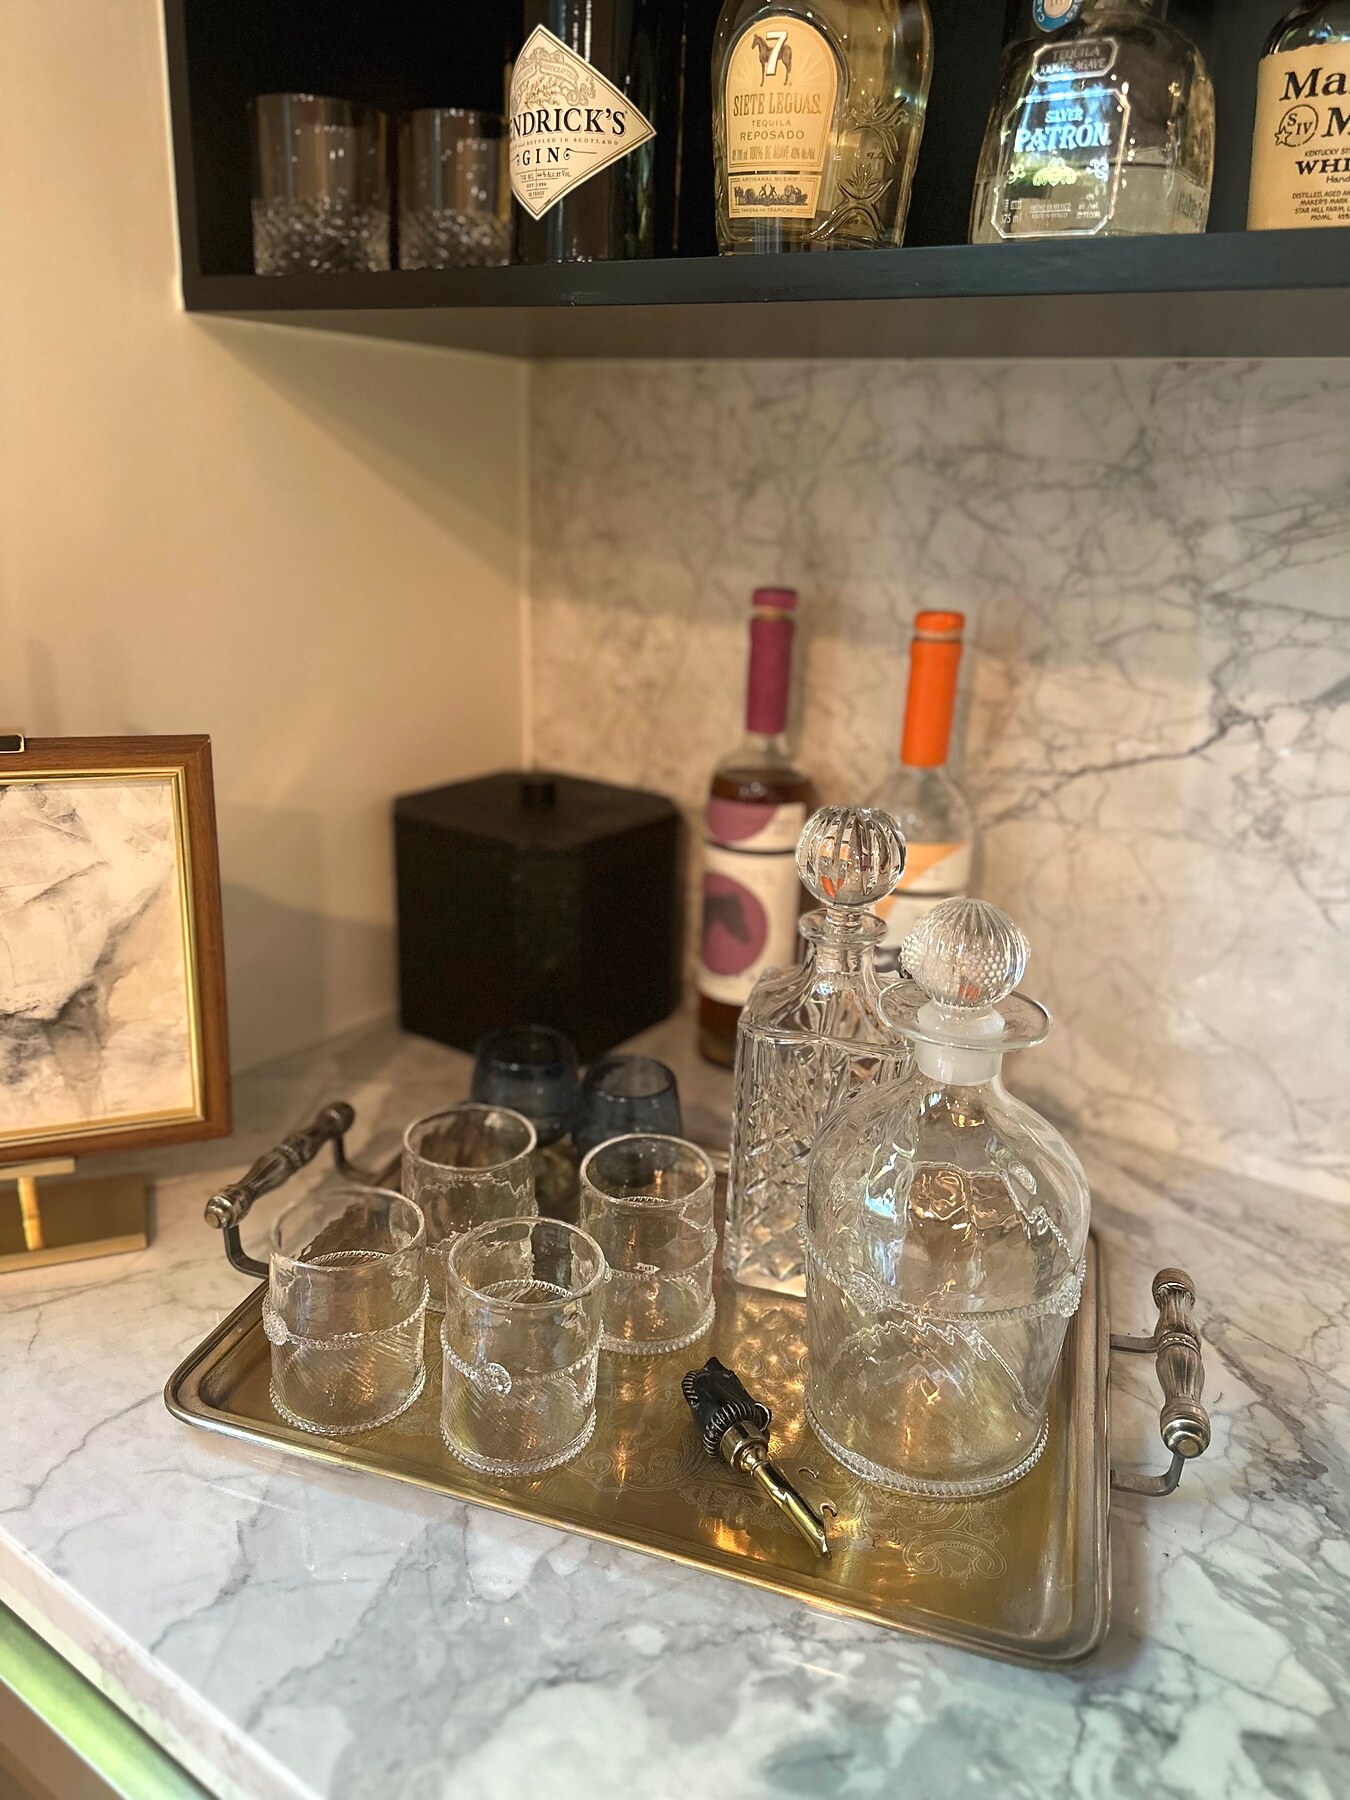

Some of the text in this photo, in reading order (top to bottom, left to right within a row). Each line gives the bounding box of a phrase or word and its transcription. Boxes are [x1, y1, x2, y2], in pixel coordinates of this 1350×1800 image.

[766, 30, 788, 76] 7
[1279, 67, 1350, 101] Ma
[734, 92, 821, 116] SIETE LEGUAS
[510, 108, 625, 138] NDRICK'S
[526, 138, 556, 146] BOTTLED
[573, 138, 619, 146] SCOTLAND
[740, 130, 804, 141] REPOSADO
[522, 147, 560, 166] GIN
[1305, 149, 1339, 157] KENTUCKY
